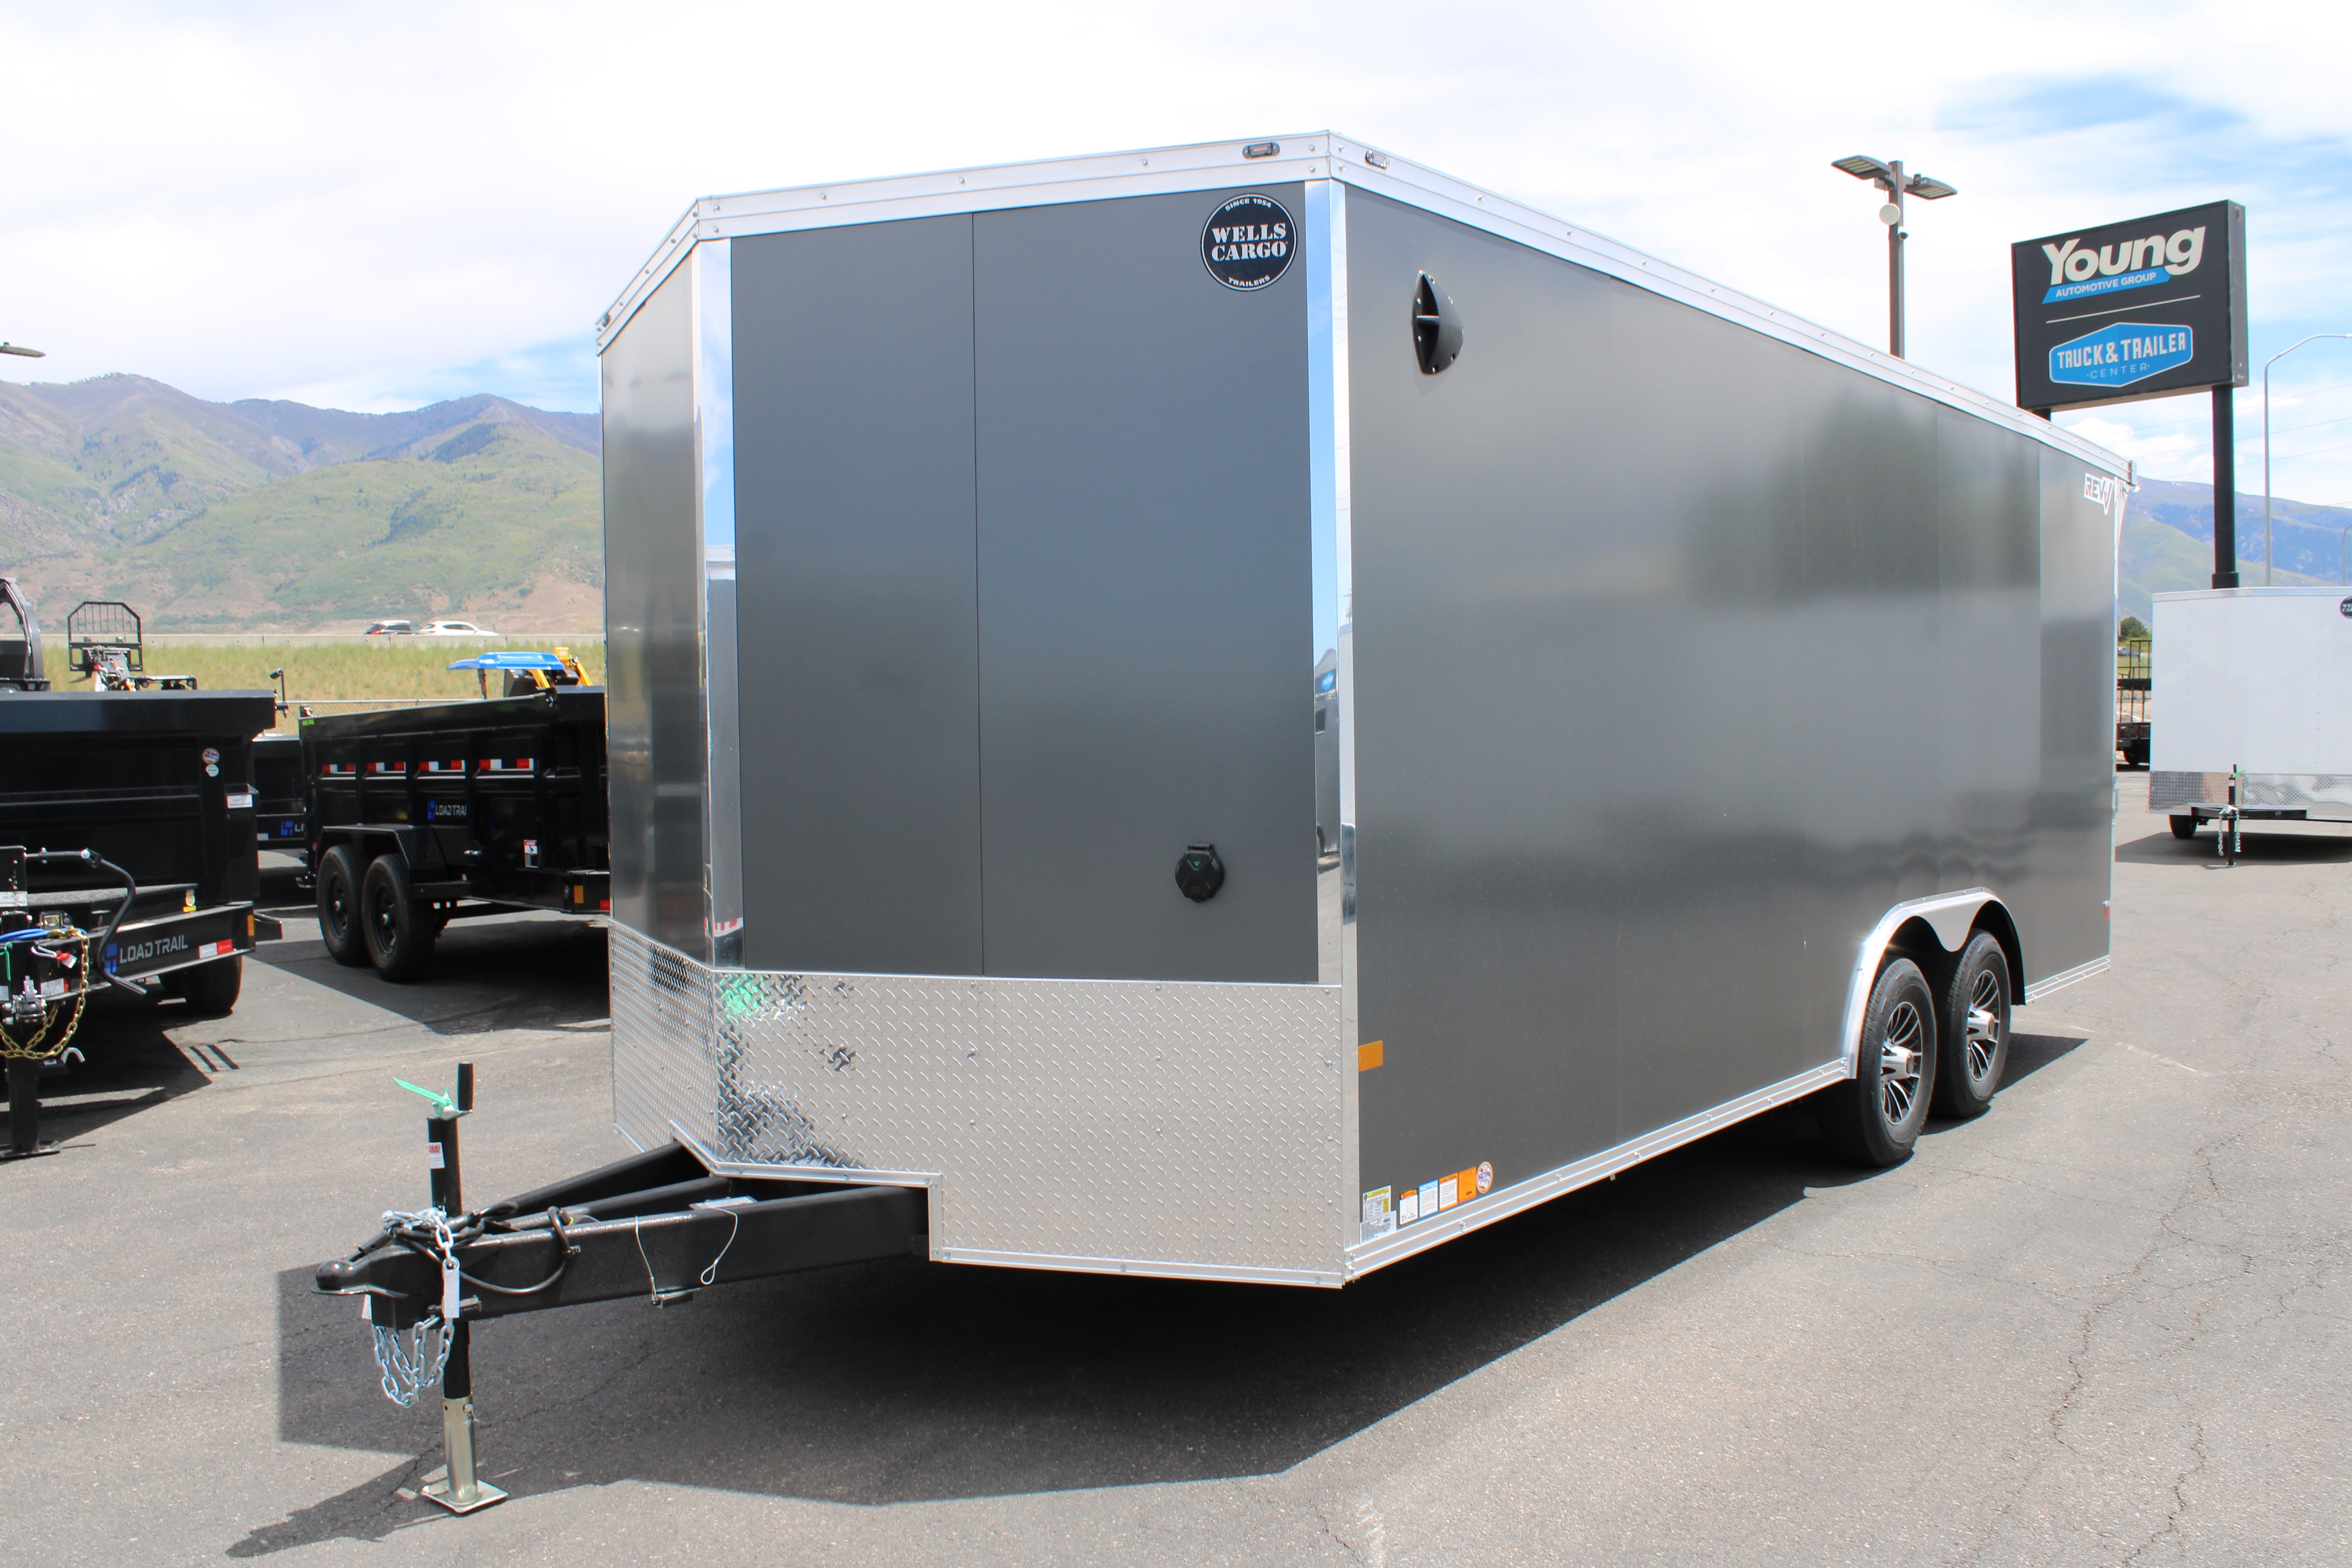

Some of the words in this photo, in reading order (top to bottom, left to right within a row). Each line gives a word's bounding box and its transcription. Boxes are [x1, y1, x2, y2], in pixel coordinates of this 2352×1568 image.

[1225, 198, 1250, 212] SINCE
[1253, 198, 1272, 209] 1954
[1211, 222, 1287, 244] WELLS
[1211, 241, 1287, 262] CARGO
[2041, 226, 2206, 286] Young
[1228, 274, 1270, 287] TRAILERS
[2056, 278, 2119, 297] AUTOMOTIVE
[2120, 272, 2157, 285] GROUP
[2057, 343, 2104, 369] TRUCK
[2105, 341, 2119, 364] &
[2120, 332, 2186, 361] TRAILER
[2089, 362, 2148, 379] CENTER
[435, 804, 452, 816] LOAD
[120, 941, 153, 964] LOAD
[155, 934, 188, 955] TRAIL
[1420, 1180, 1438, 1192] NOTICE
